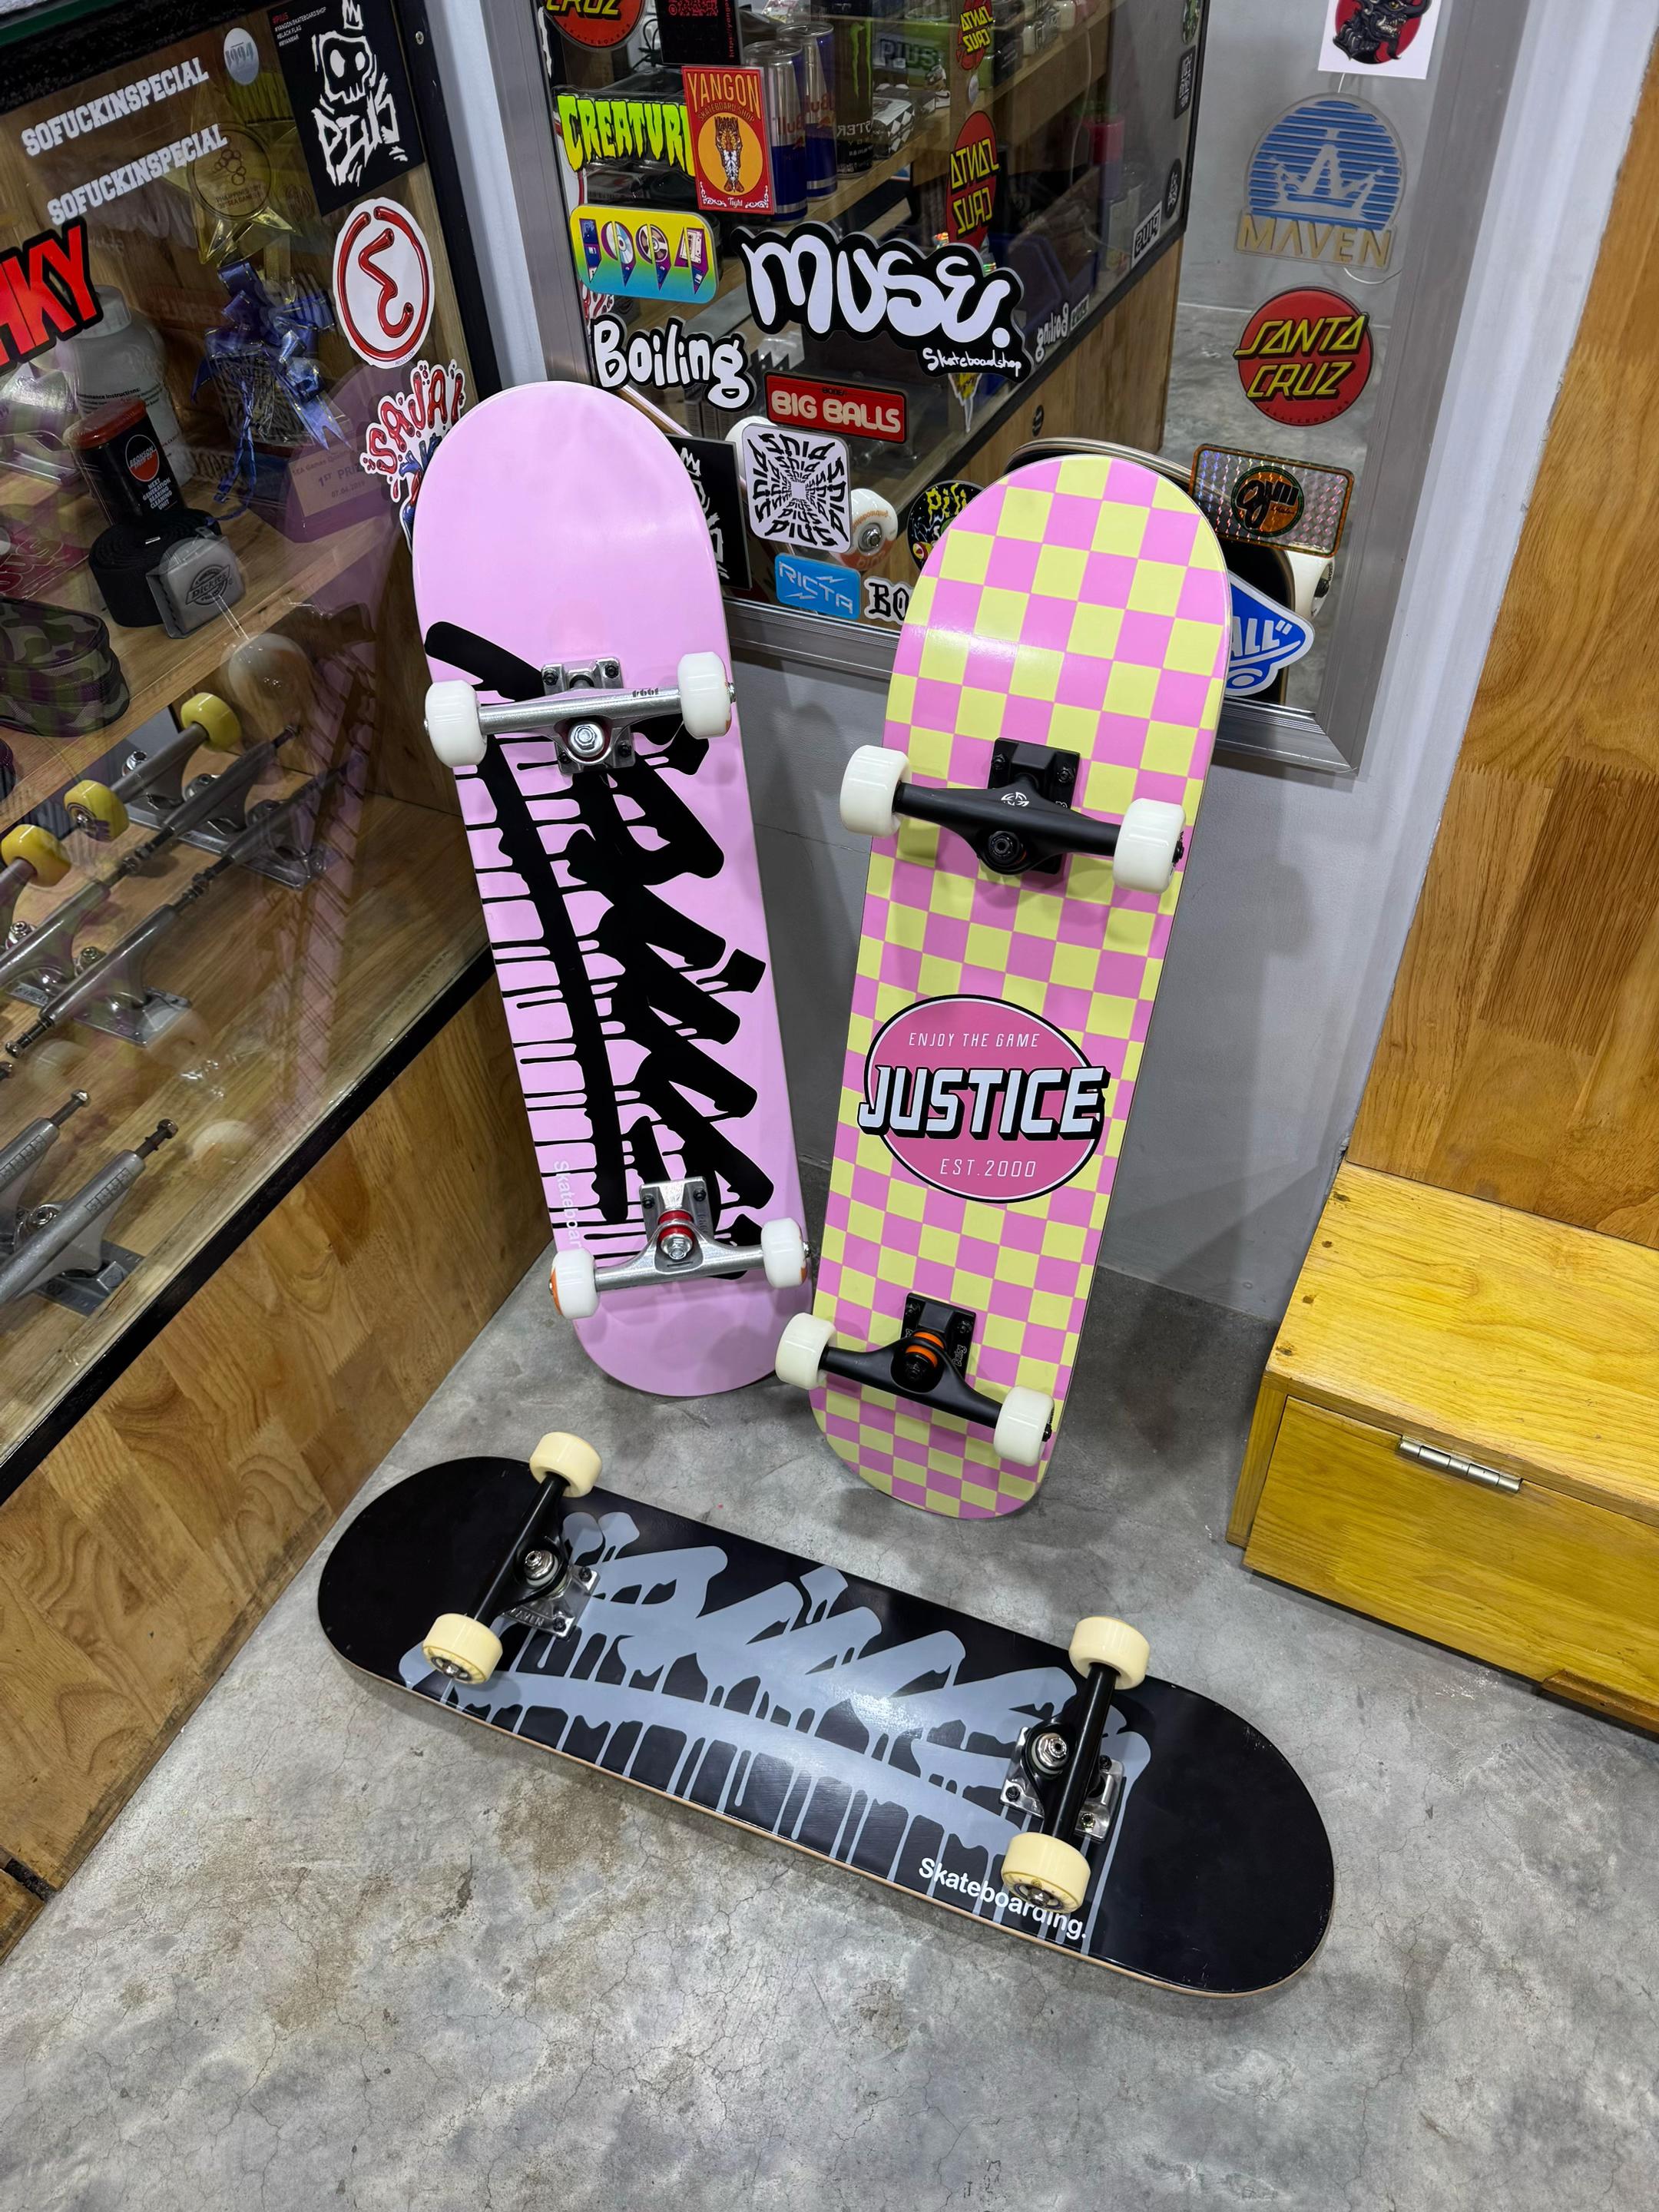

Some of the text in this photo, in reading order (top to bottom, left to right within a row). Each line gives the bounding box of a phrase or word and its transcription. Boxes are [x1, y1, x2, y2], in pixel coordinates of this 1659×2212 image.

[21, 56, 210, 157] SOFUCKINSPECIAL
[687, 72, 763, 121] YANGON
[697, 101, 755, 122] SKATEBOARD SHOP
[47, 123, 228, 226] SOFUCKINSPECIAL
[1237, 213, 1392, 267] MAVEN
[1233, 314, 1369, 359] SANTA
[594, 320, 748, 408] Boiling
[1247, 361, 1354, 400] CRUZ
[771, 389, 901, 434] BIG BALLS
[142, 476, 171, 501] GENERATION
[147, 477, 161, 490] NEXT
[337, 462, 366, 480] PRIZ
[150, 490, 173, 509] CLEANING
[158, 499, 170, 511] UNIT
[778, 561, 854, 615] RICTA
[909, 1032, 1041, 1048] ENJOY THE GAME
[857, 1065, 1107, 1138] JUSTICE
[553, 1160, 582, 1249] Skateboar
